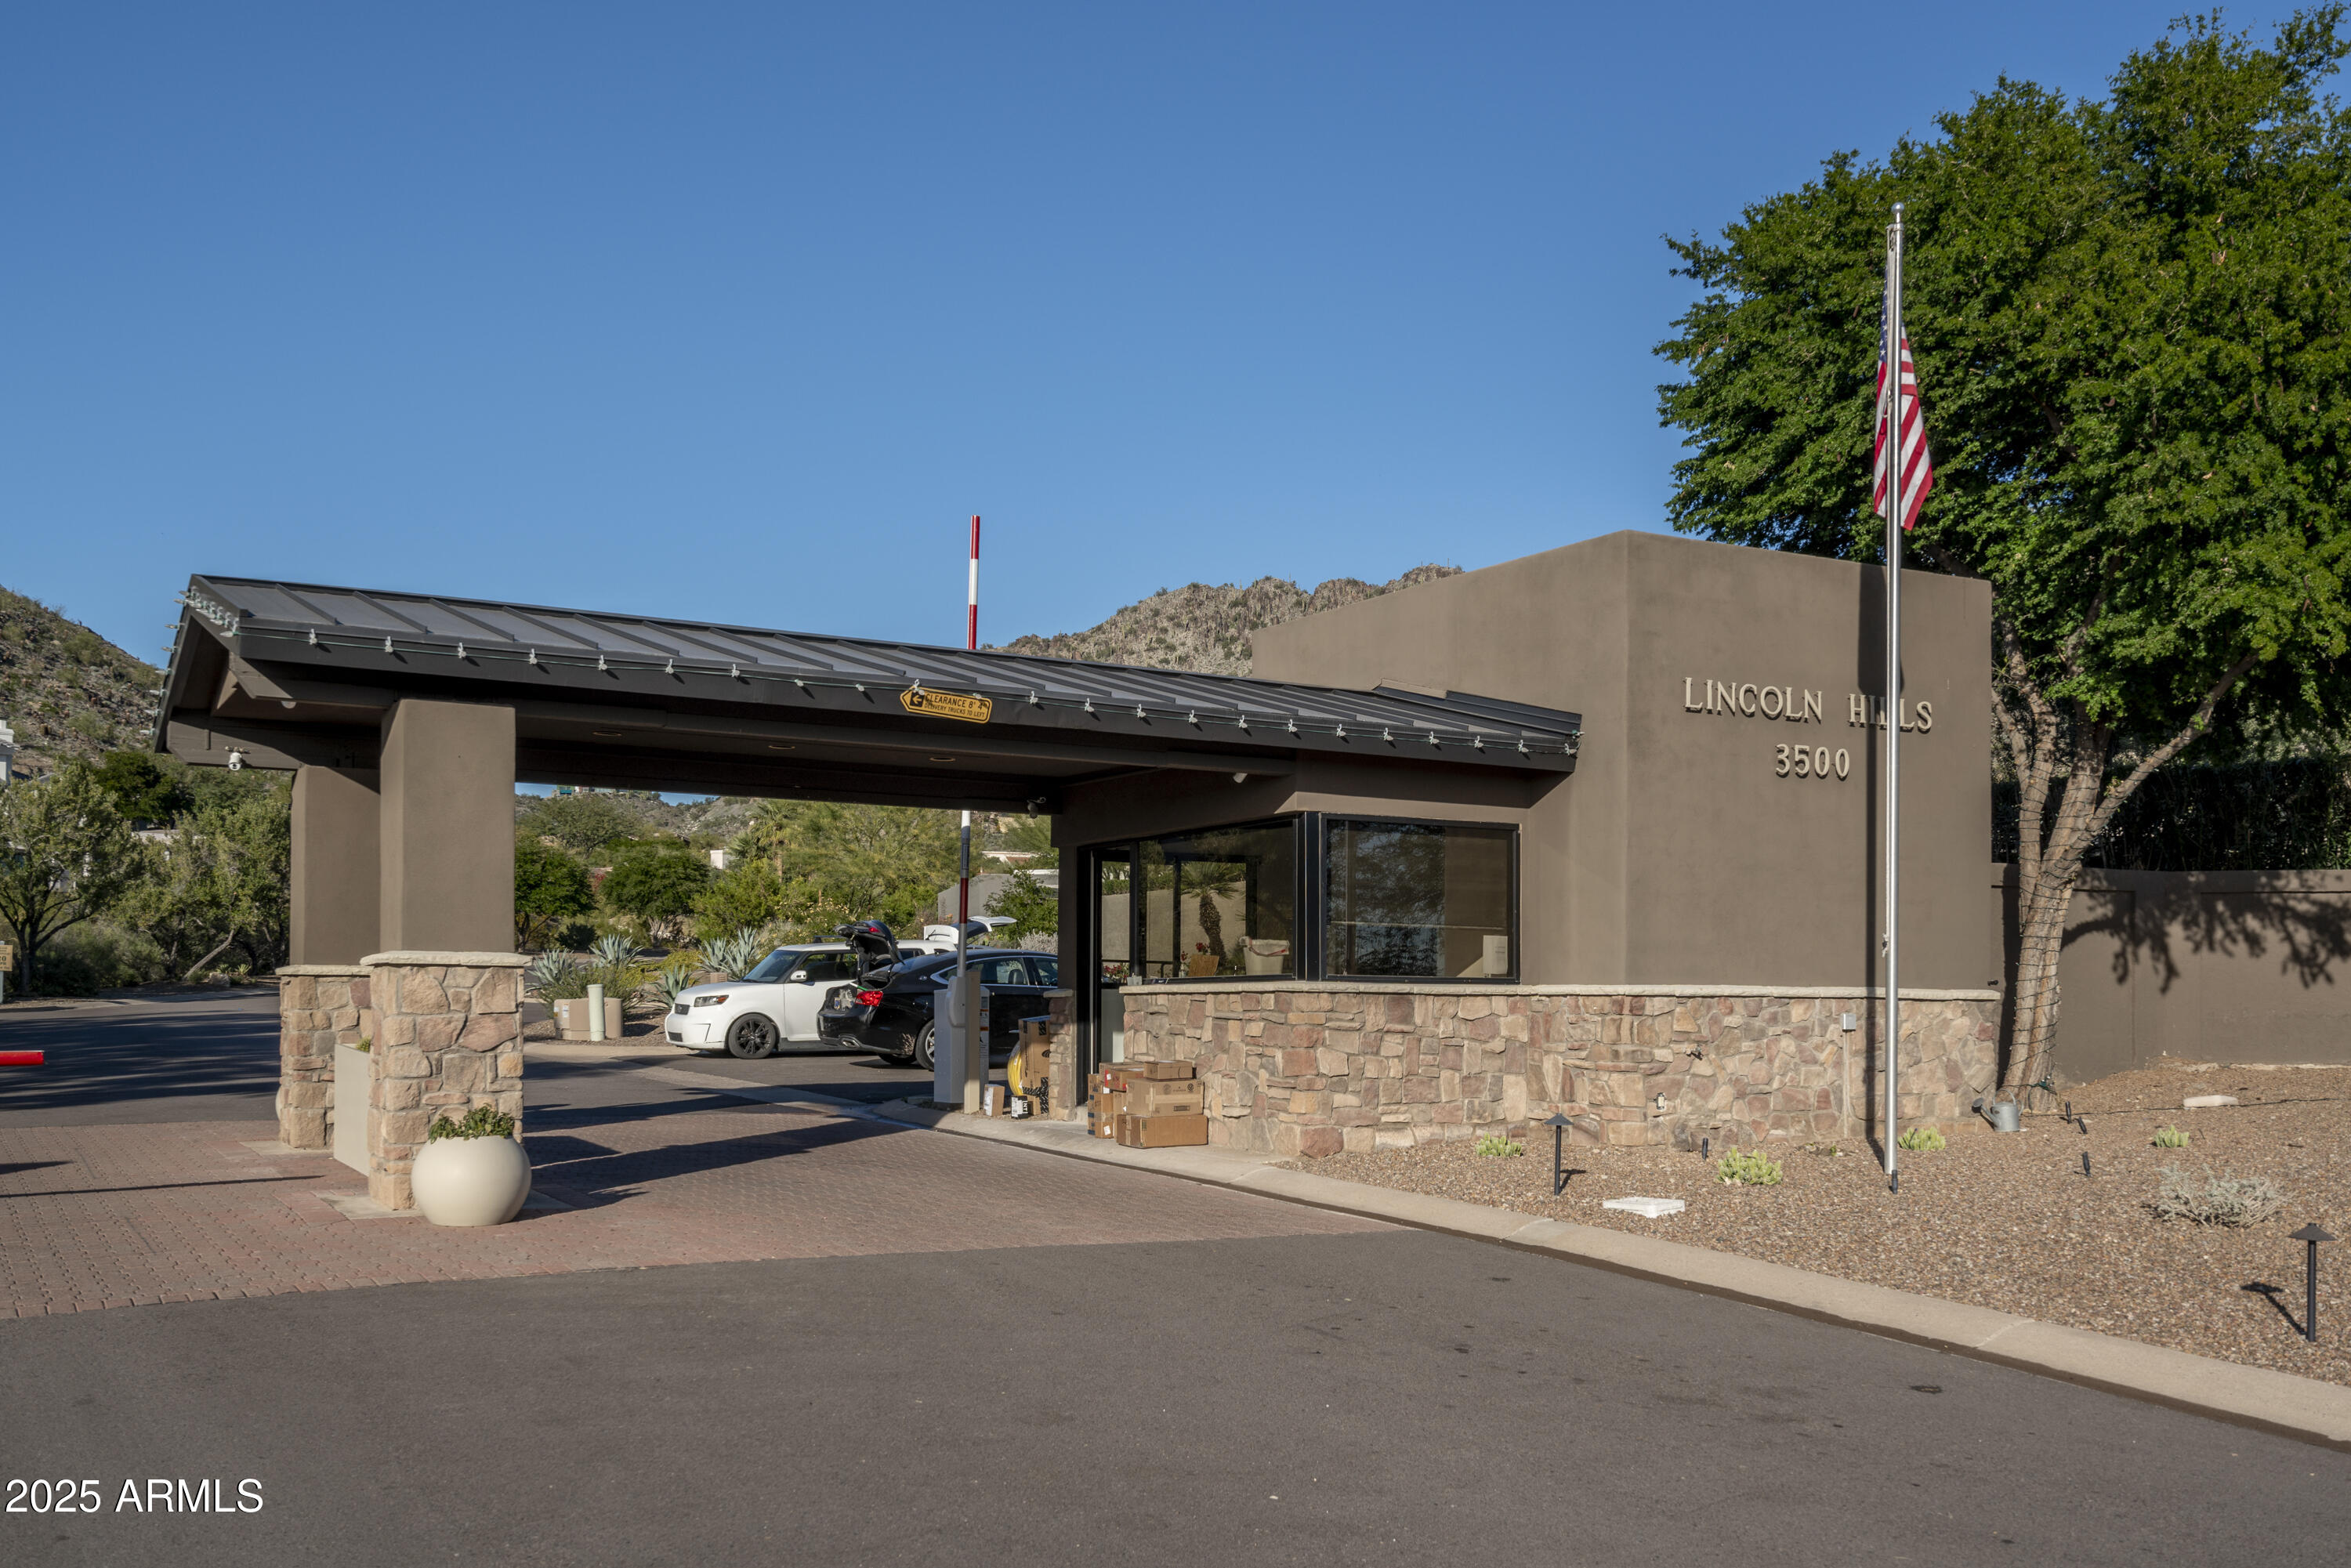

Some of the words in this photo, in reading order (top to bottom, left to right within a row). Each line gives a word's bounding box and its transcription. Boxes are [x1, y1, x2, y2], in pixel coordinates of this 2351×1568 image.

[925, 703, 947, 712] DELIVERY
[926, 693, 966, 708] CLEARANCE
[1685, 677, 1823, 721] LINCOLN
[1776, 744, 1850, 777] 3500
